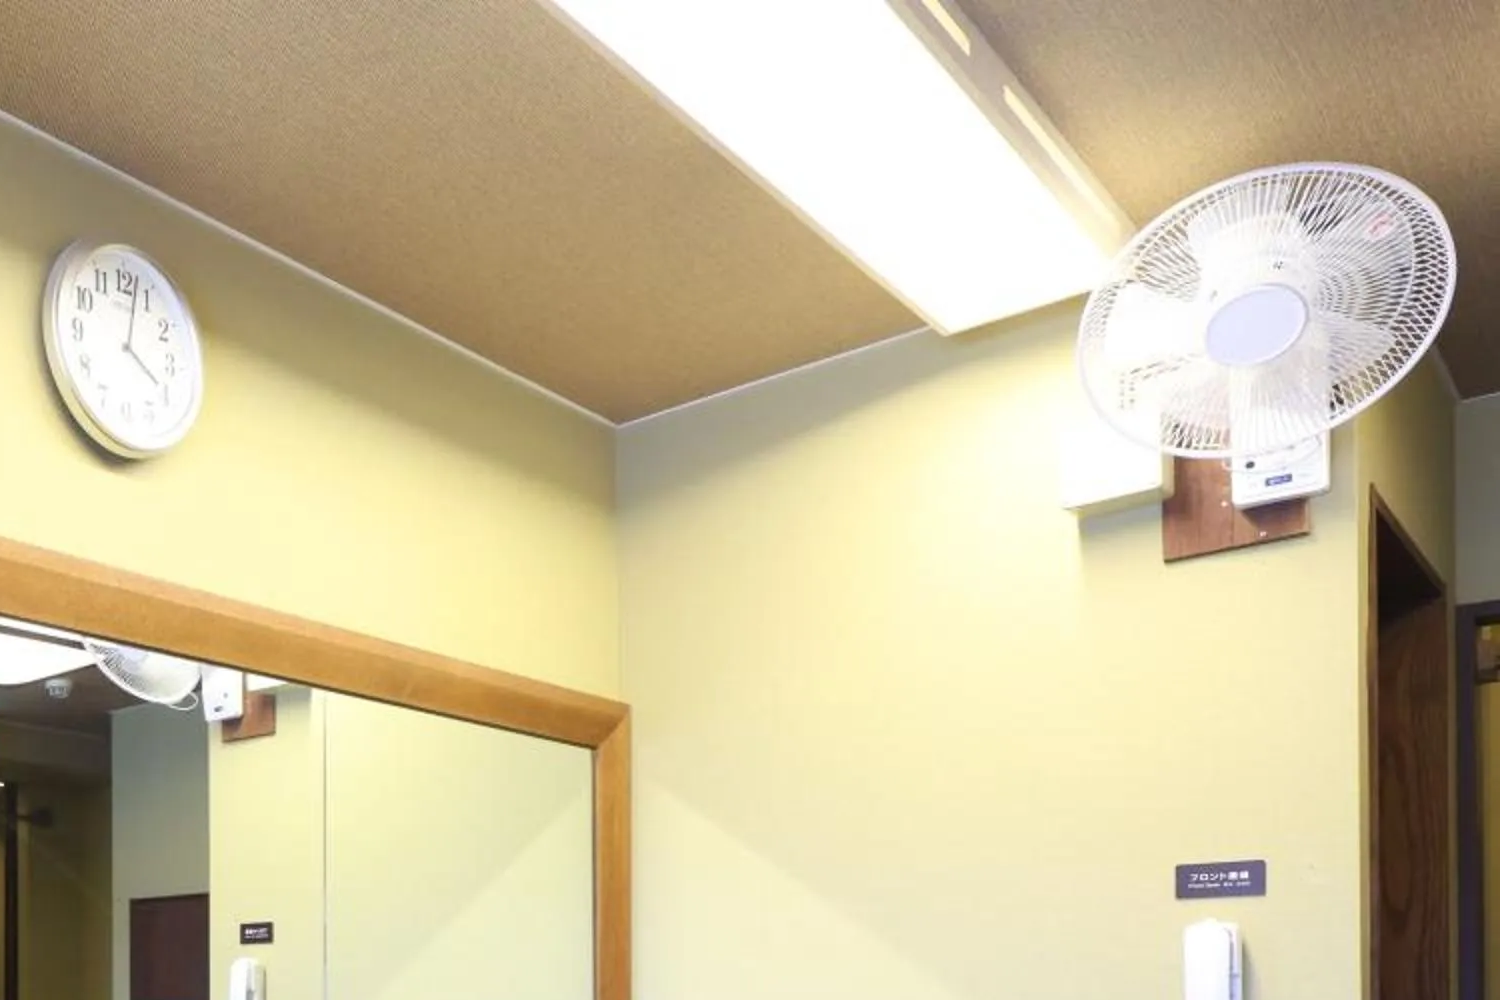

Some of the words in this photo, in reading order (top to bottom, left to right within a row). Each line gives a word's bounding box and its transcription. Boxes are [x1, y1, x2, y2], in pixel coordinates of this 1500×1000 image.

[94, 268, 108, 295] 11
[115, 268, 133, 296] 12
[77, 286, 93, 313] 10
[143, 289, 150, 313] 1
[72, 317, 83, 342] 9
[158, 319, 169, 342] 2
[165, 353, 176, 378] 3
